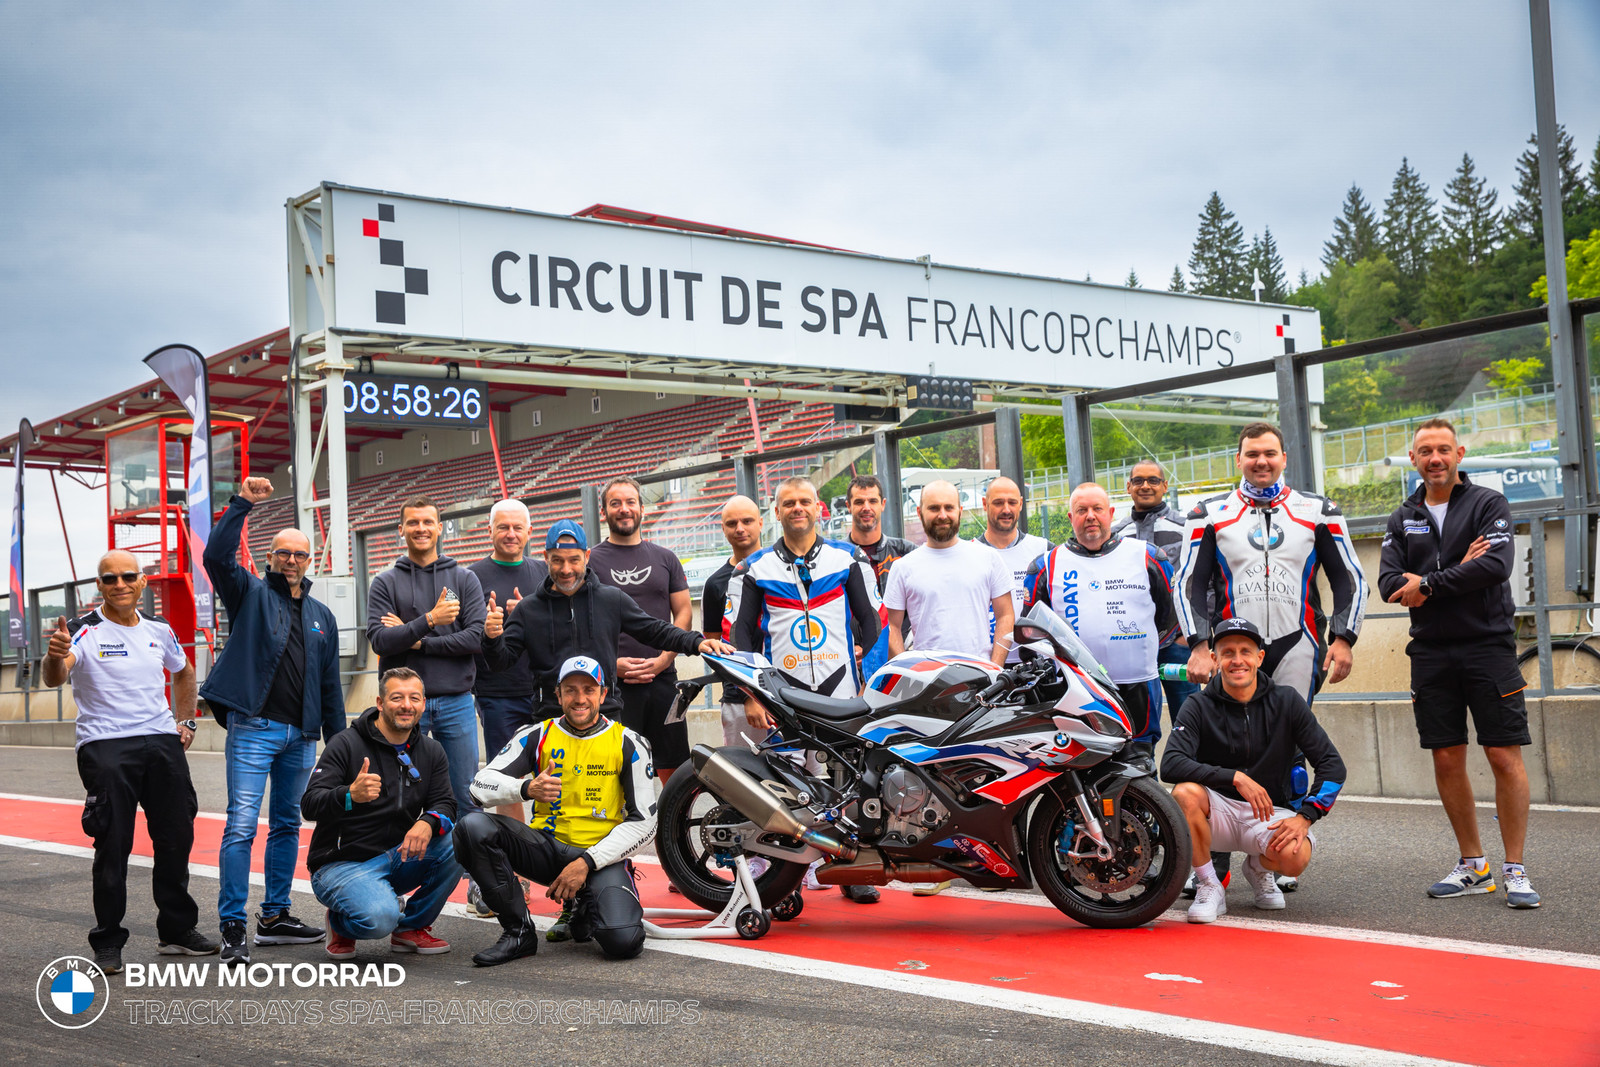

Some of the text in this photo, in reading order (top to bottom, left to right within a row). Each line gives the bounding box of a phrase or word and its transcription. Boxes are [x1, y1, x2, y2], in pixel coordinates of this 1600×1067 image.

[491, 250, 1234, 367] CIRCUIT DE SPA FRANCORCHAMPS
[343, 380, 481, 419] 08:58:26
[1238, 581, 1295, 596] EVASION
[1109, 633, 1147, 641] MICHELIN
[796, 652, 839, 662] Location
[475, 780, 499, 791] Motorrad
[620, 843, 638, 858] BMW
